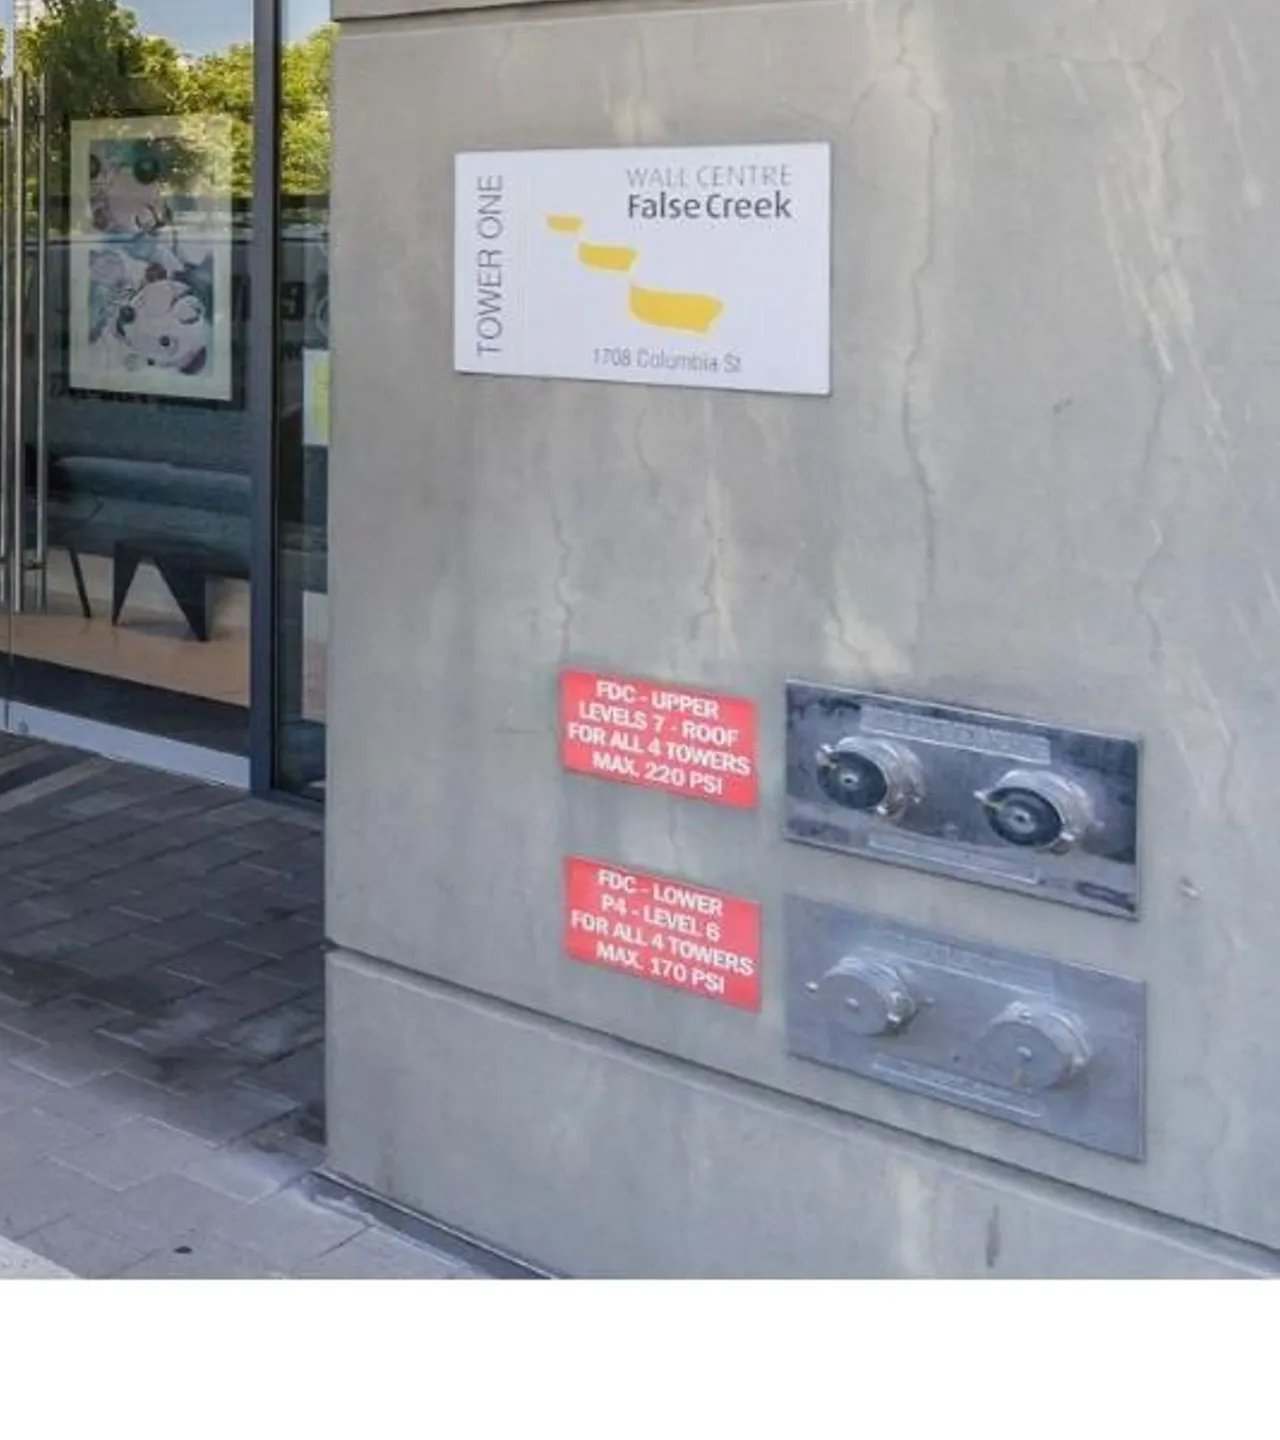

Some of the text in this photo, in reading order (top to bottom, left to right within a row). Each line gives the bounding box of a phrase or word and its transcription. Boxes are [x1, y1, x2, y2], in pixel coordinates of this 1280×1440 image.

[626, 163, 792, 189] WALL CENTRE
[628, 189, 793, 220] False Creek
[476, 174, 504, 358] TOWER ONE
[593, 346, 631, 367] 1708
[636, 346, 718, 373] Columbia
[578, 700, 648, 731] LEVELS
[653, 715, 665, 734] 7
[681, 721, 740, 747] ROOF
[595, 679, 637, 703] FDC
[650, 691, 720, 720] UPPER
[568, 721, 752, 777] FOR ALL 4 TOWERS
[592, 750, 724, 796] MAX. 220 PSI
[597, 868, 638, 894] FDC
[652, 883, 724, 917] LOWER
[600, 893, 628, 917] P4
[643, 904, 704, 938] LEVEL
[705, 921, 722, 943] 6
[570, 909, 755, 976] FOR ALL 4 TOWERS
[596, 941, 726, 994] MAX. 170 PSI
